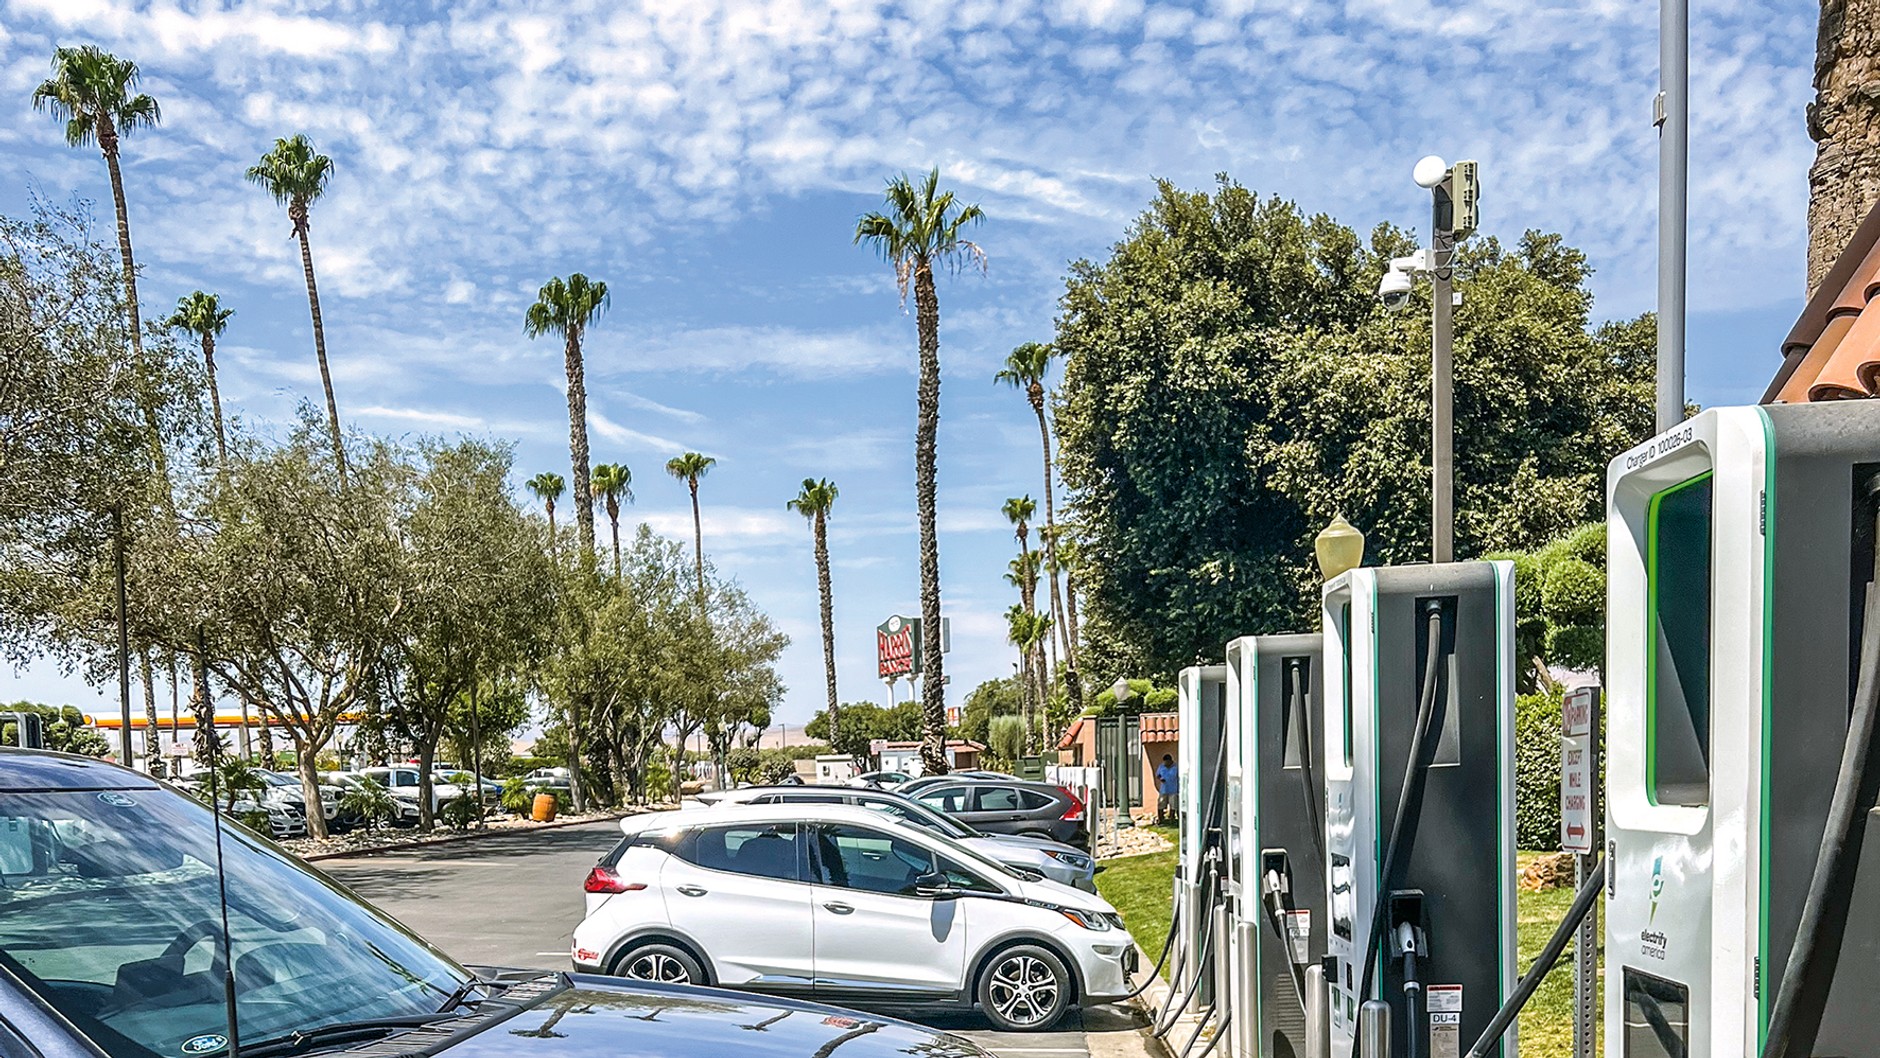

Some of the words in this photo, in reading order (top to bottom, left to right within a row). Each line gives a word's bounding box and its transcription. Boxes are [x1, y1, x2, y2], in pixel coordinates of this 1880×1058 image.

[1626, 450, 1650, 470] Charger
[1649, 444, 1655, 459] ID
[1658, 427, 1693, 455] 100026-03
[1568, 749, 1582, 765] EXCEPT
[1641, 929, 1667, 949] electrify
[1641, 945, 1665, 960] america
[1433, 1014, 1457, 1022] DU-4
